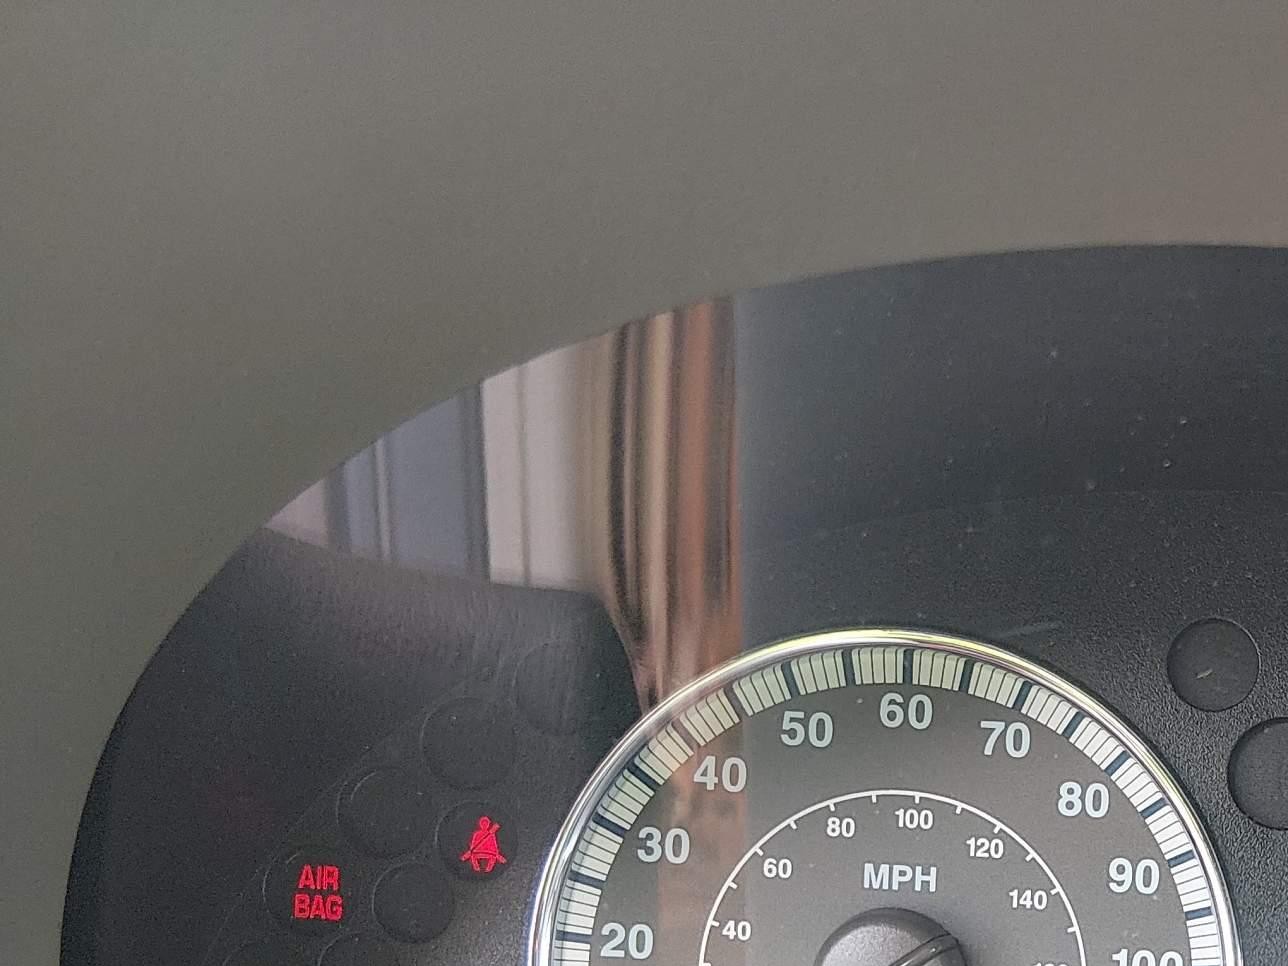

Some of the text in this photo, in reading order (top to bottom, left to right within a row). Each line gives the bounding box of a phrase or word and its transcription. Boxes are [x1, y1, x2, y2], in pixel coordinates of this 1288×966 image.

[880, 693, 932, 729] 60
[781, 711, 833, 747] 50
[981, 721, 1030, 757] 70
[694, 756, 746, 792] 40
[1058, 782, 1109, 818] 80
[827, 817, 855, 837] 80
[895, 809, 933, 829] 100
[638, 827, 689, 864] 30
[967, 837, 1003, 858] 120
[298, 864, 339, 891] AIR
[764, 858, 791, 878] 60
[864, 863, 936, 892] MPH
[1109, 858, 1159, 894] 90
[294, 893, 342, 920] BAG
[1009, 890, 1047, 910] 140
[600, 923, 653, 959] 20
[722, 921, 751, 940] 40
